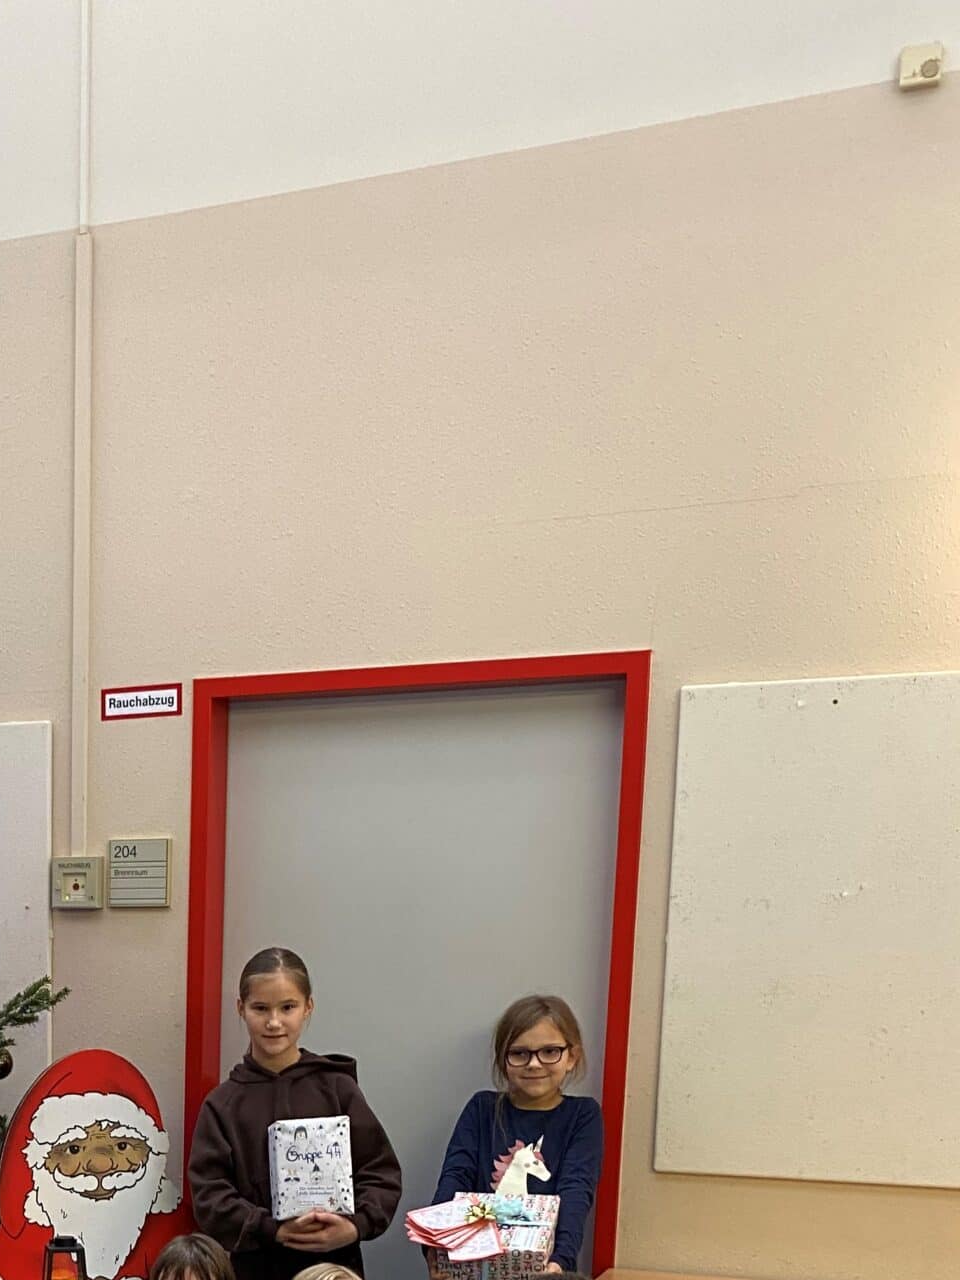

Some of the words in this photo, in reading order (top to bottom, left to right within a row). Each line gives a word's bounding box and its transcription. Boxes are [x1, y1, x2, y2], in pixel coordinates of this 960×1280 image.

[108, 696, 175, 709] Rauchabzug
[114, 845, 137, 858] 204
[286, 1145, 324, 1163] Gruppe
